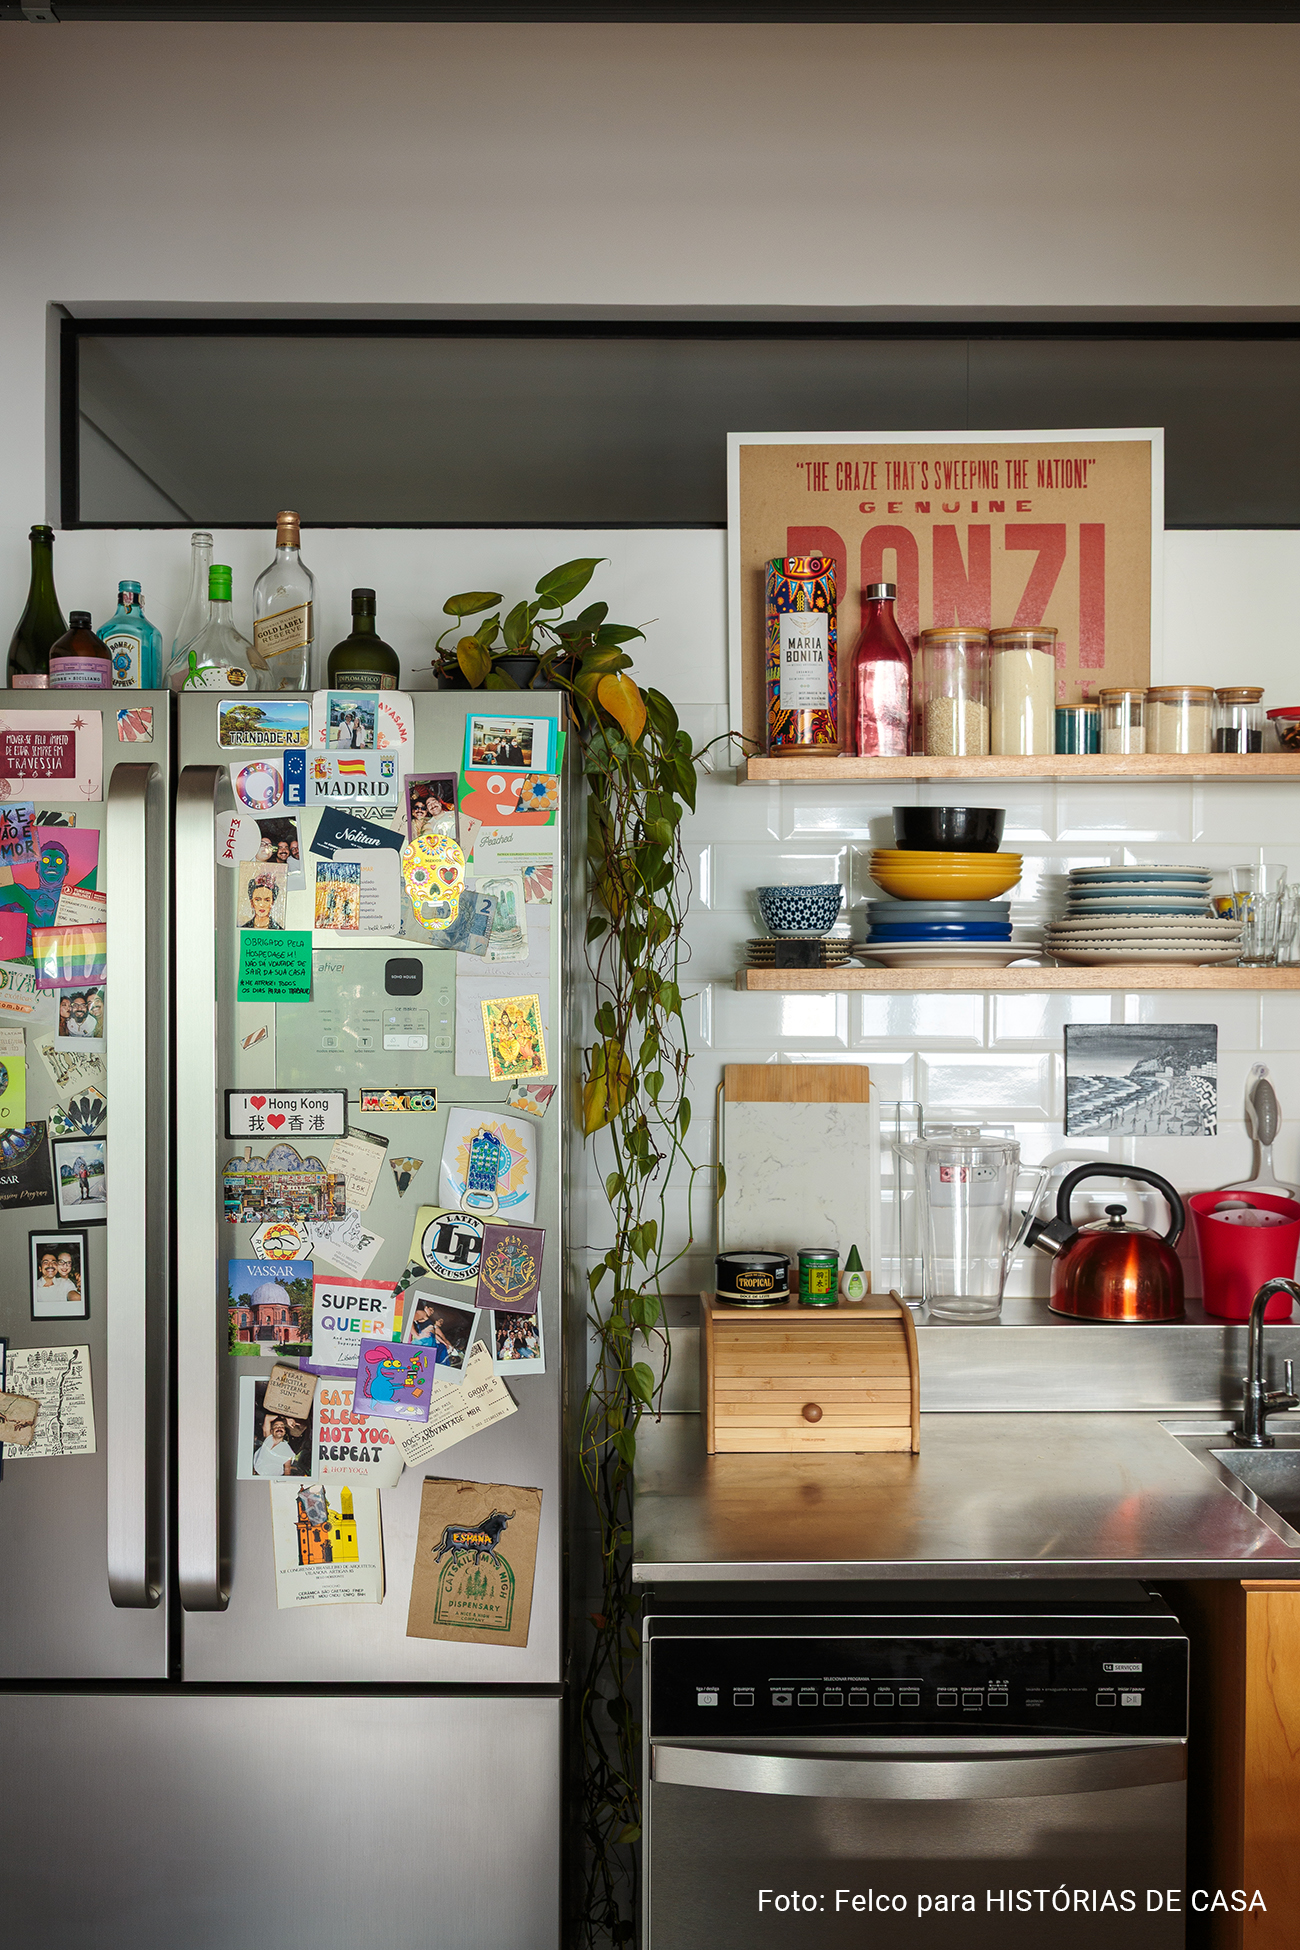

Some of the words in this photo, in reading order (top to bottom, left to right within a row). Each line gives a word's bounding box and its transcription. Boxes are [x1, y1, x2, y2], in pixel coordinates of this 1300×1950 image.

[836, 462, 878, 491] CRAZE
[934, 460, 998, 490] SWEEPING
[1005, 460, 1029, 489] THE
[859, 500, 1032, 514] GENUINE
[787, 522, 1105, 670] PONZI
[257, 627, 278, 639] GOLD
[279, 618, 303, 632] LABEL
[262, 624, 303, 643] RESERVE
[110, 642, 135, 652] BOMBAY
[788, 638, 821, 649] MARIA
[786, 650, 823, 662] BONITA
[6, 735, 31, 745] MOVER-SE
[34, 735, 46, 744] PELO
[6, 746, 12, 756] DE
[32, 746, 52, 756] SEMPRE
[54, 746, 64, 756] EM
[7, 757, 62, 769] TRAVESSIA
[289, 784, 300, 802] E
[315, 781, 389, 796] MADRID
[335, 828, 381, 846] Nolitan
[481, 899, 492, 913] 2
[244, 938, 284, 946] OBRIGADO
[244, 1099, 247, 1109] I
[269, 1098, 297, 1111] Hong
[300, 1098, 329, 1111] Kong
[249, 1115, 265, 1132] 我
[288, 1114, 325, 1132] 香港
[351, 1184, 366, 1193] 15K
[446, 1215, 480, 1228] LATIN
[431, 1222, 483, 1266] LP
[247, 1266, 295, 1277] VASSAR
[426, 1253, 480, 1278] PERCUSSION
[739, 1278, 771, 1287] TROPICAL
[322, 1294, 387, 1312] SUPER-
[321, 1316, 385, 1335] QUEER
[284, 1371, 303, 1381] VERAE
[270, 1380, 310, 1395] SEMPITERNAE
[467, 1383, 489, 1399] GROUP
[320, 1390, 353, 1405] EAT
[421, 1415, 465, 1442] AADVANTAGE
[466, 1406, 482, 1417] MBR
[320, 1427, 356, 1444] HOT
[402, 1433, 421, 1448] DOCS
[319, 1446, 382, 1462] REPEAT
[453, 1533, 492, 1545] ESPAÑA
[499, 1572, 508, 1599] HIGH
[449, 1601, 500, 1612] DISPENSARY
